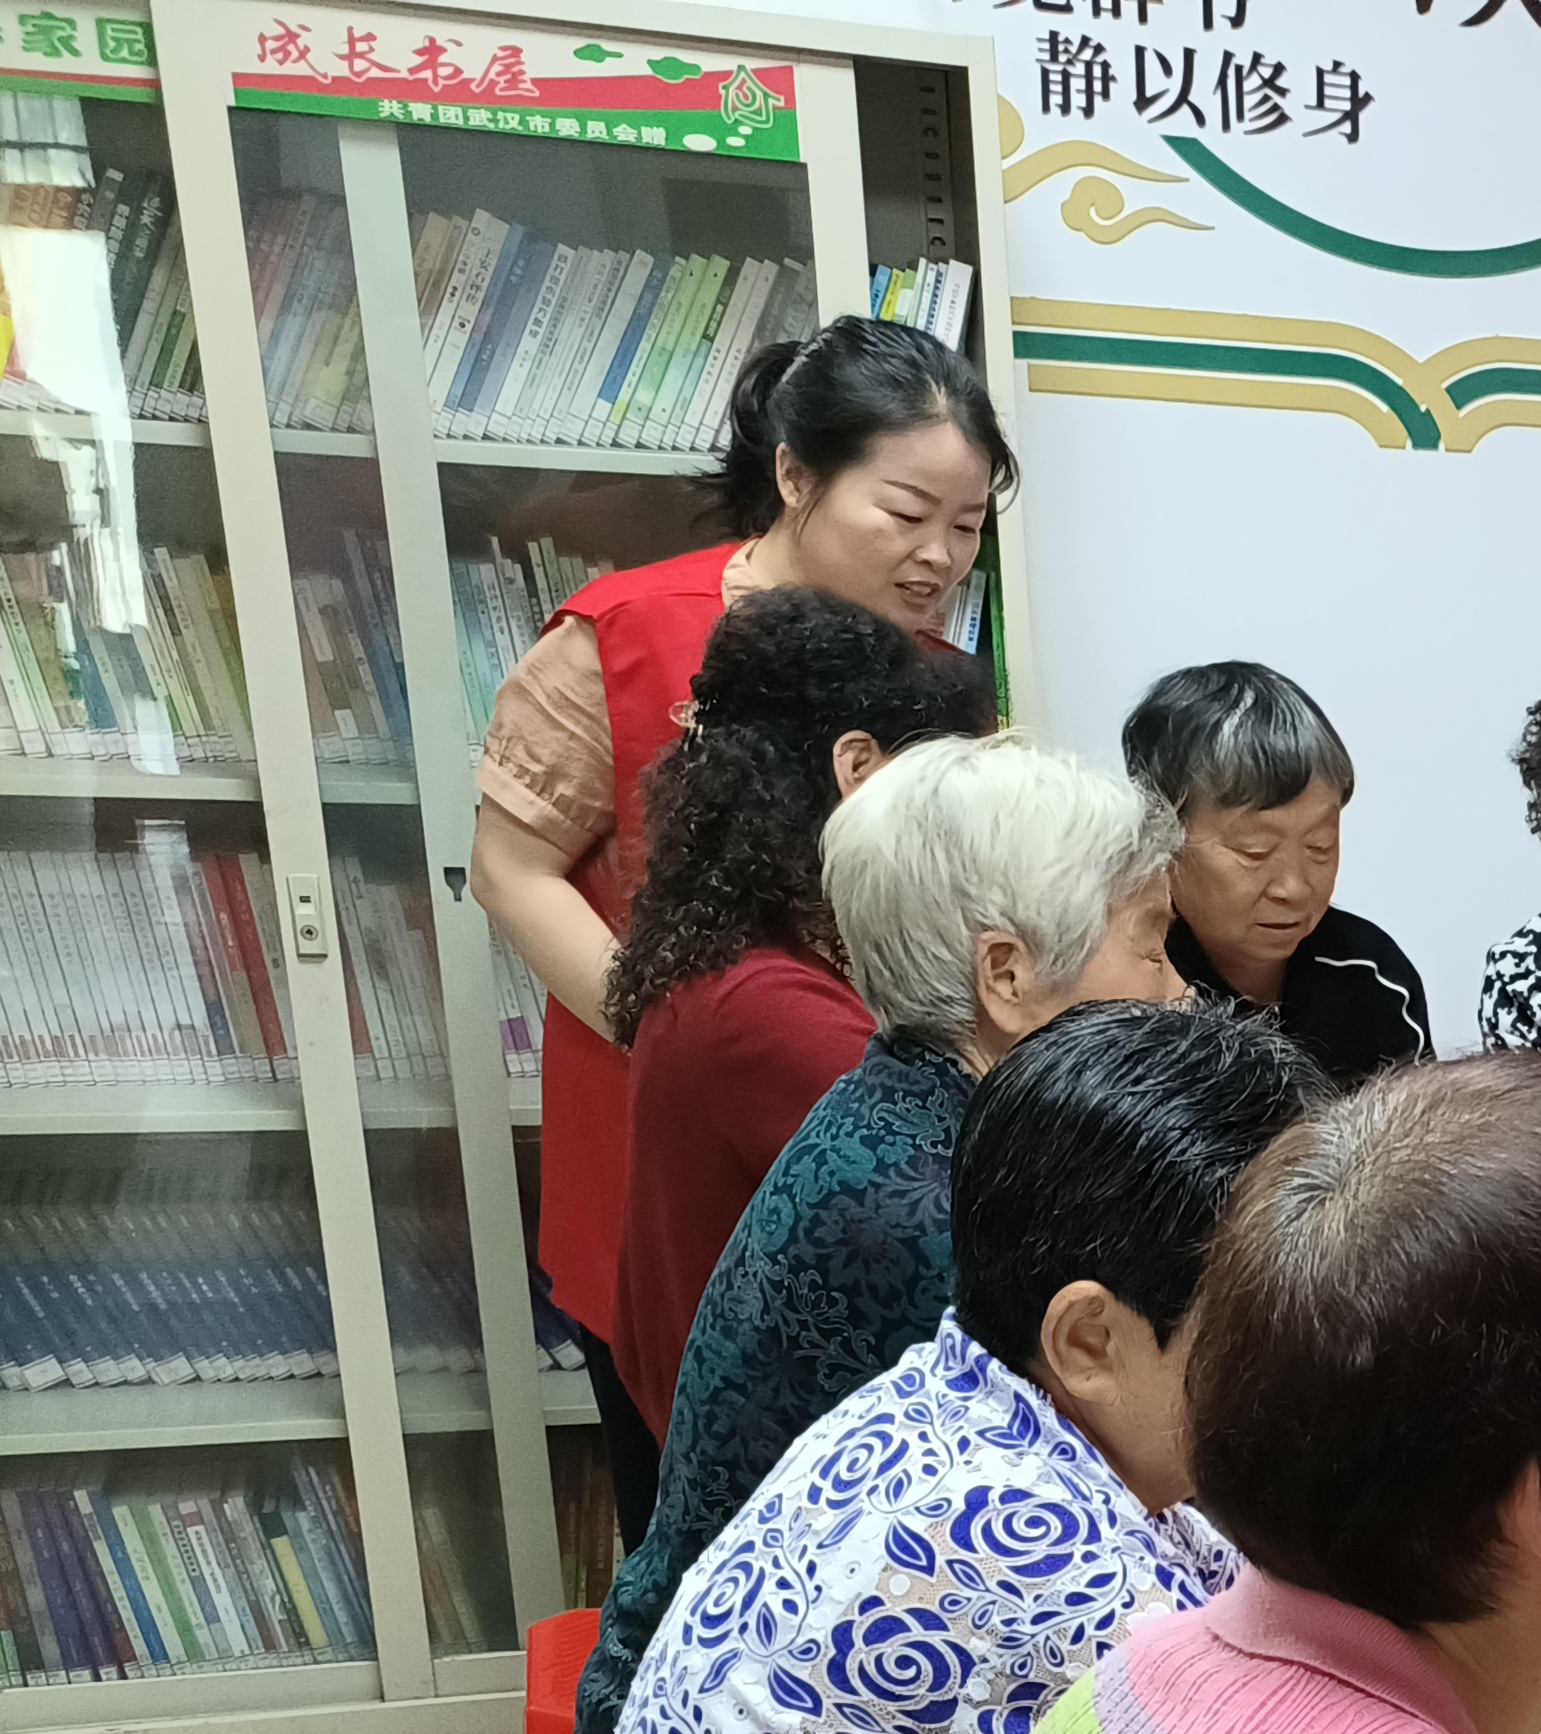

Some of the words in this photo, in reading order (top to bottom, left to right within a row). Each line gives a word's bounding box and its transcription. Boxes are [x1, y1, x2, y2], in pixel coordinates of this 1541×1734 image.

[0, 10, 157, 67] 家园
[256, 17, 540, 97] 成长书屋
[1035, 29, 1376, 145] 静以修身
[378, 99, 667, 147] 共青团武汉市委员会赠
